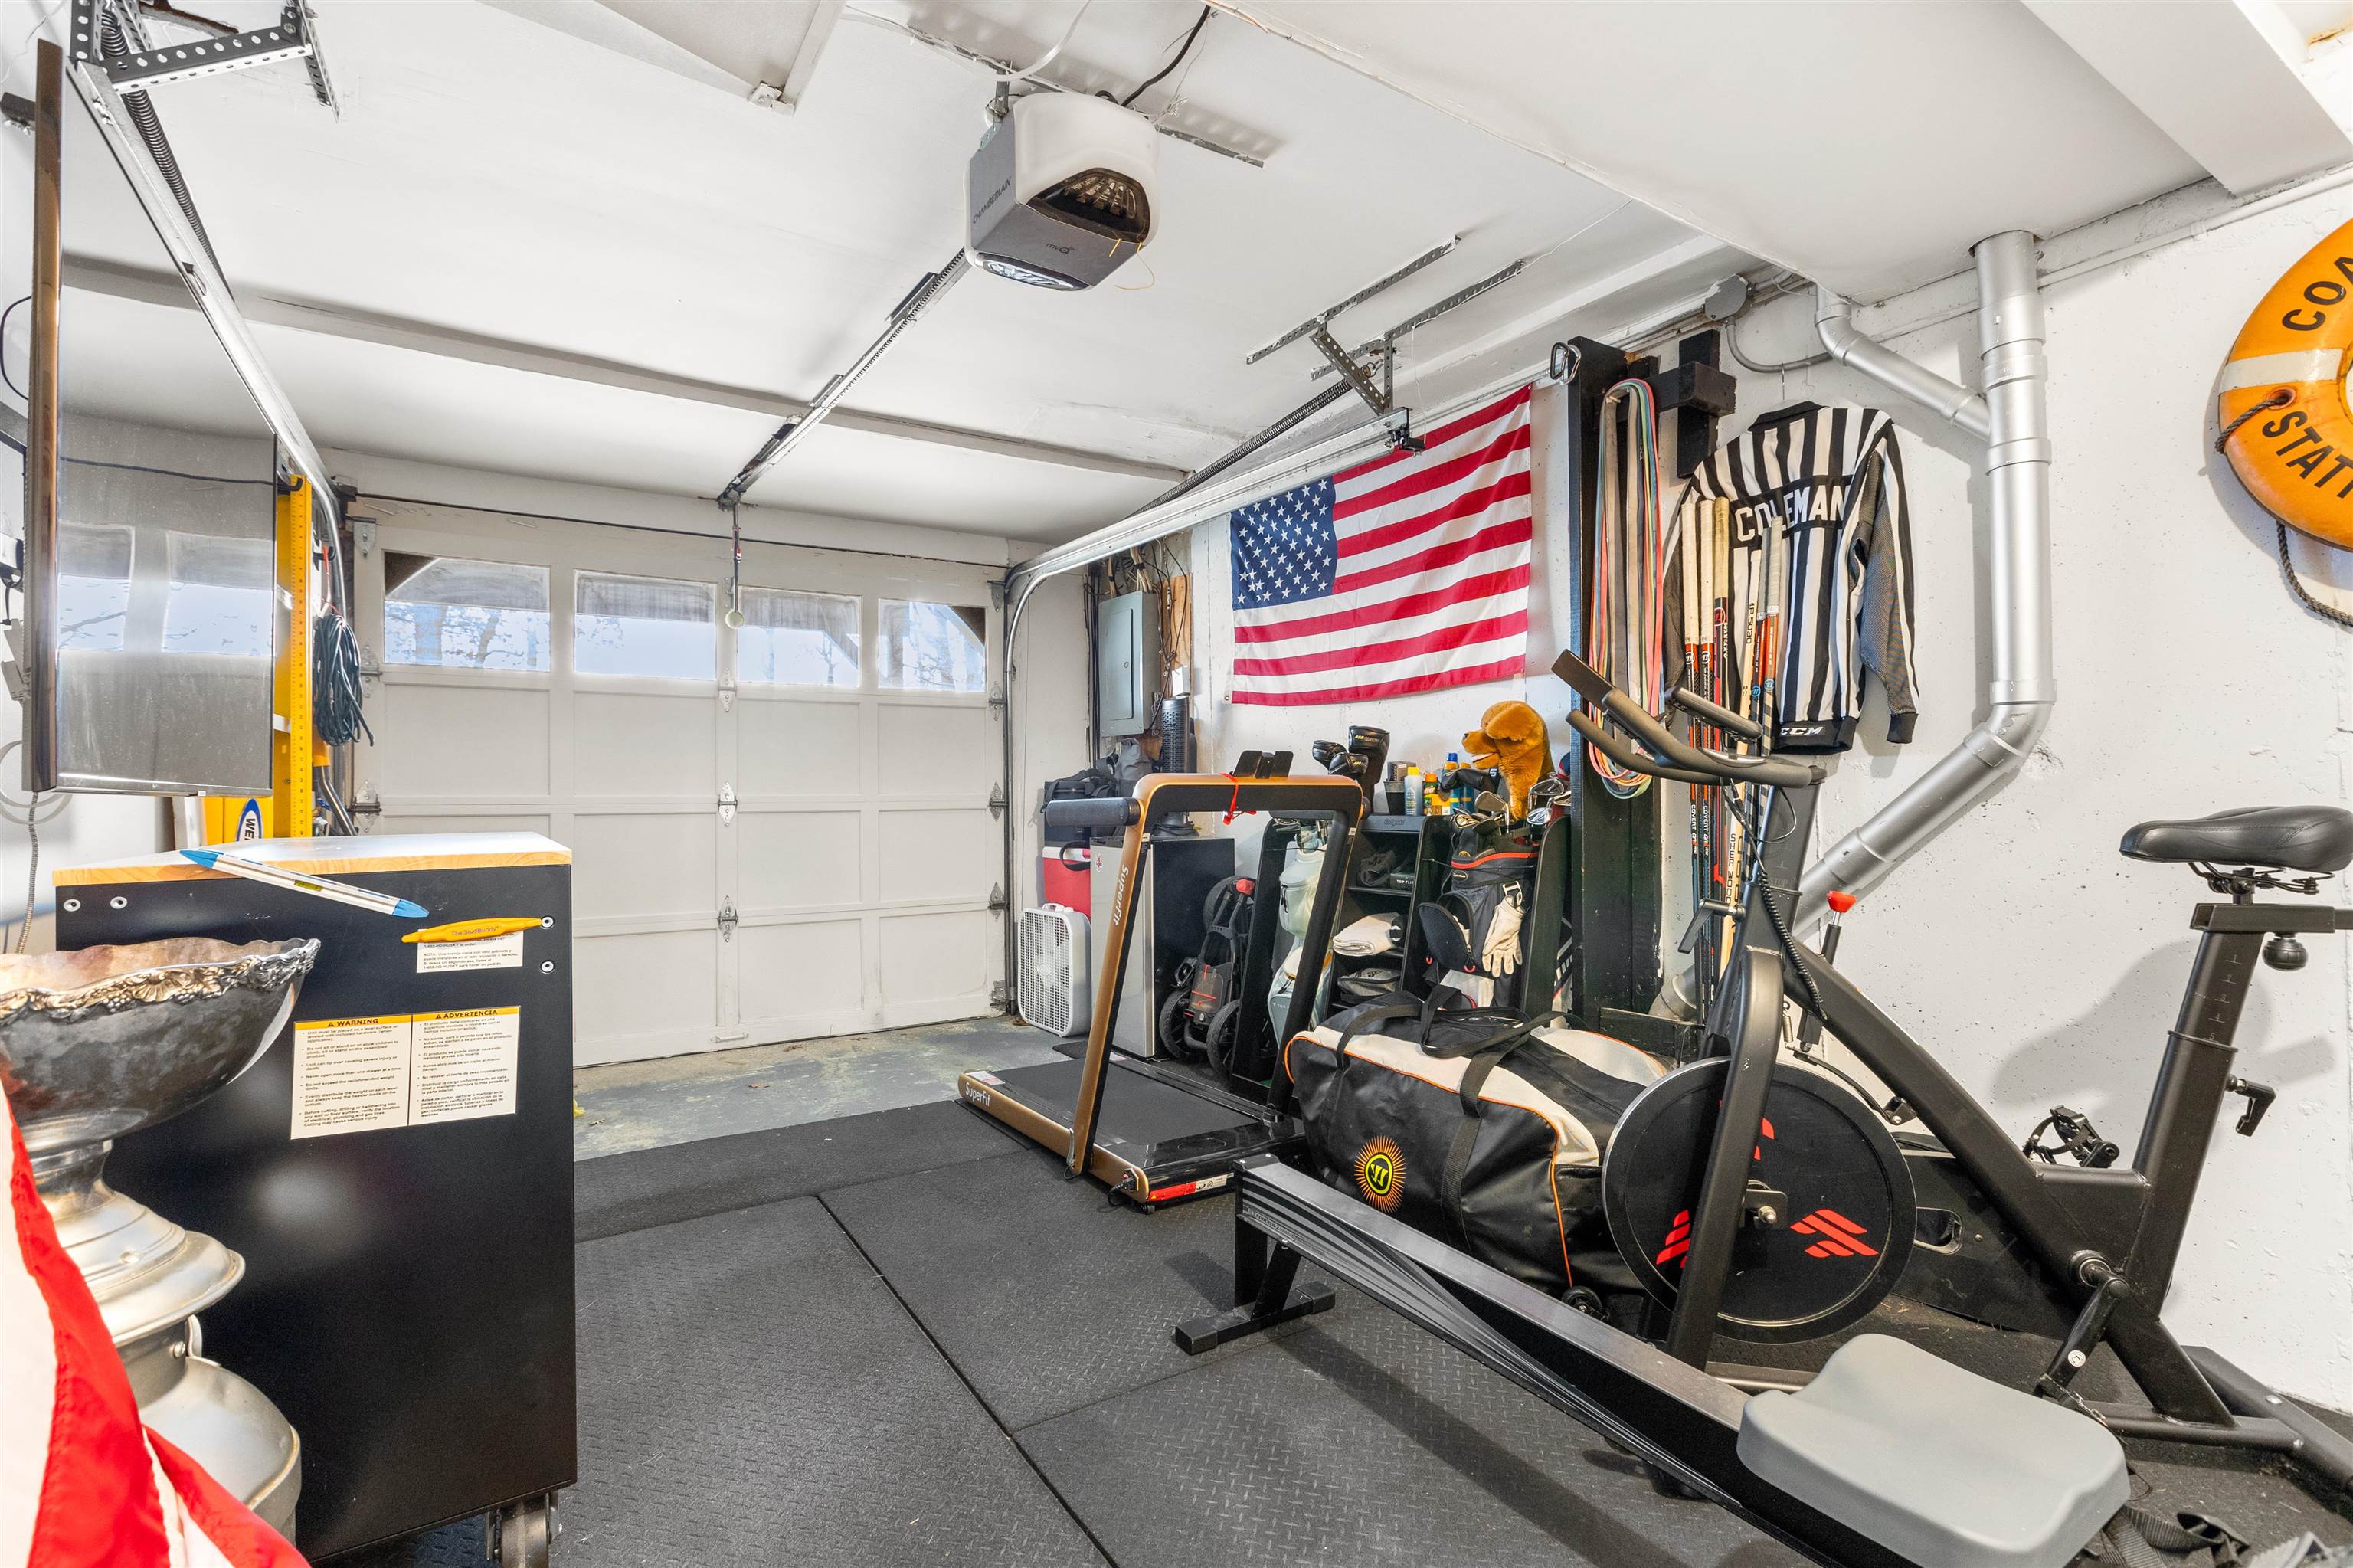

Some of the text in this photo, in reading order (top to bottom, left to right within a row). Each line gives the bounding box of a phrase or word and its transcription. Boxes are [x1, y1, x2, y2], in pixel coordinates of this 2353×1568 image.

[973, 176, 1012, 224] CHAMBERLAIN
[1735, 485, 1851, 542] COLEMAN
[1781, 726, 1824, 735] CCM
[1489, 768, 1497, 777] 5
[244, 818, 256, 840] WE
[443, 1010, 498, 1019] ADVERTENCIA
[336, 1018, 379, 1027] WARNING
[966, 1082, 990, 1107] SuperFit
